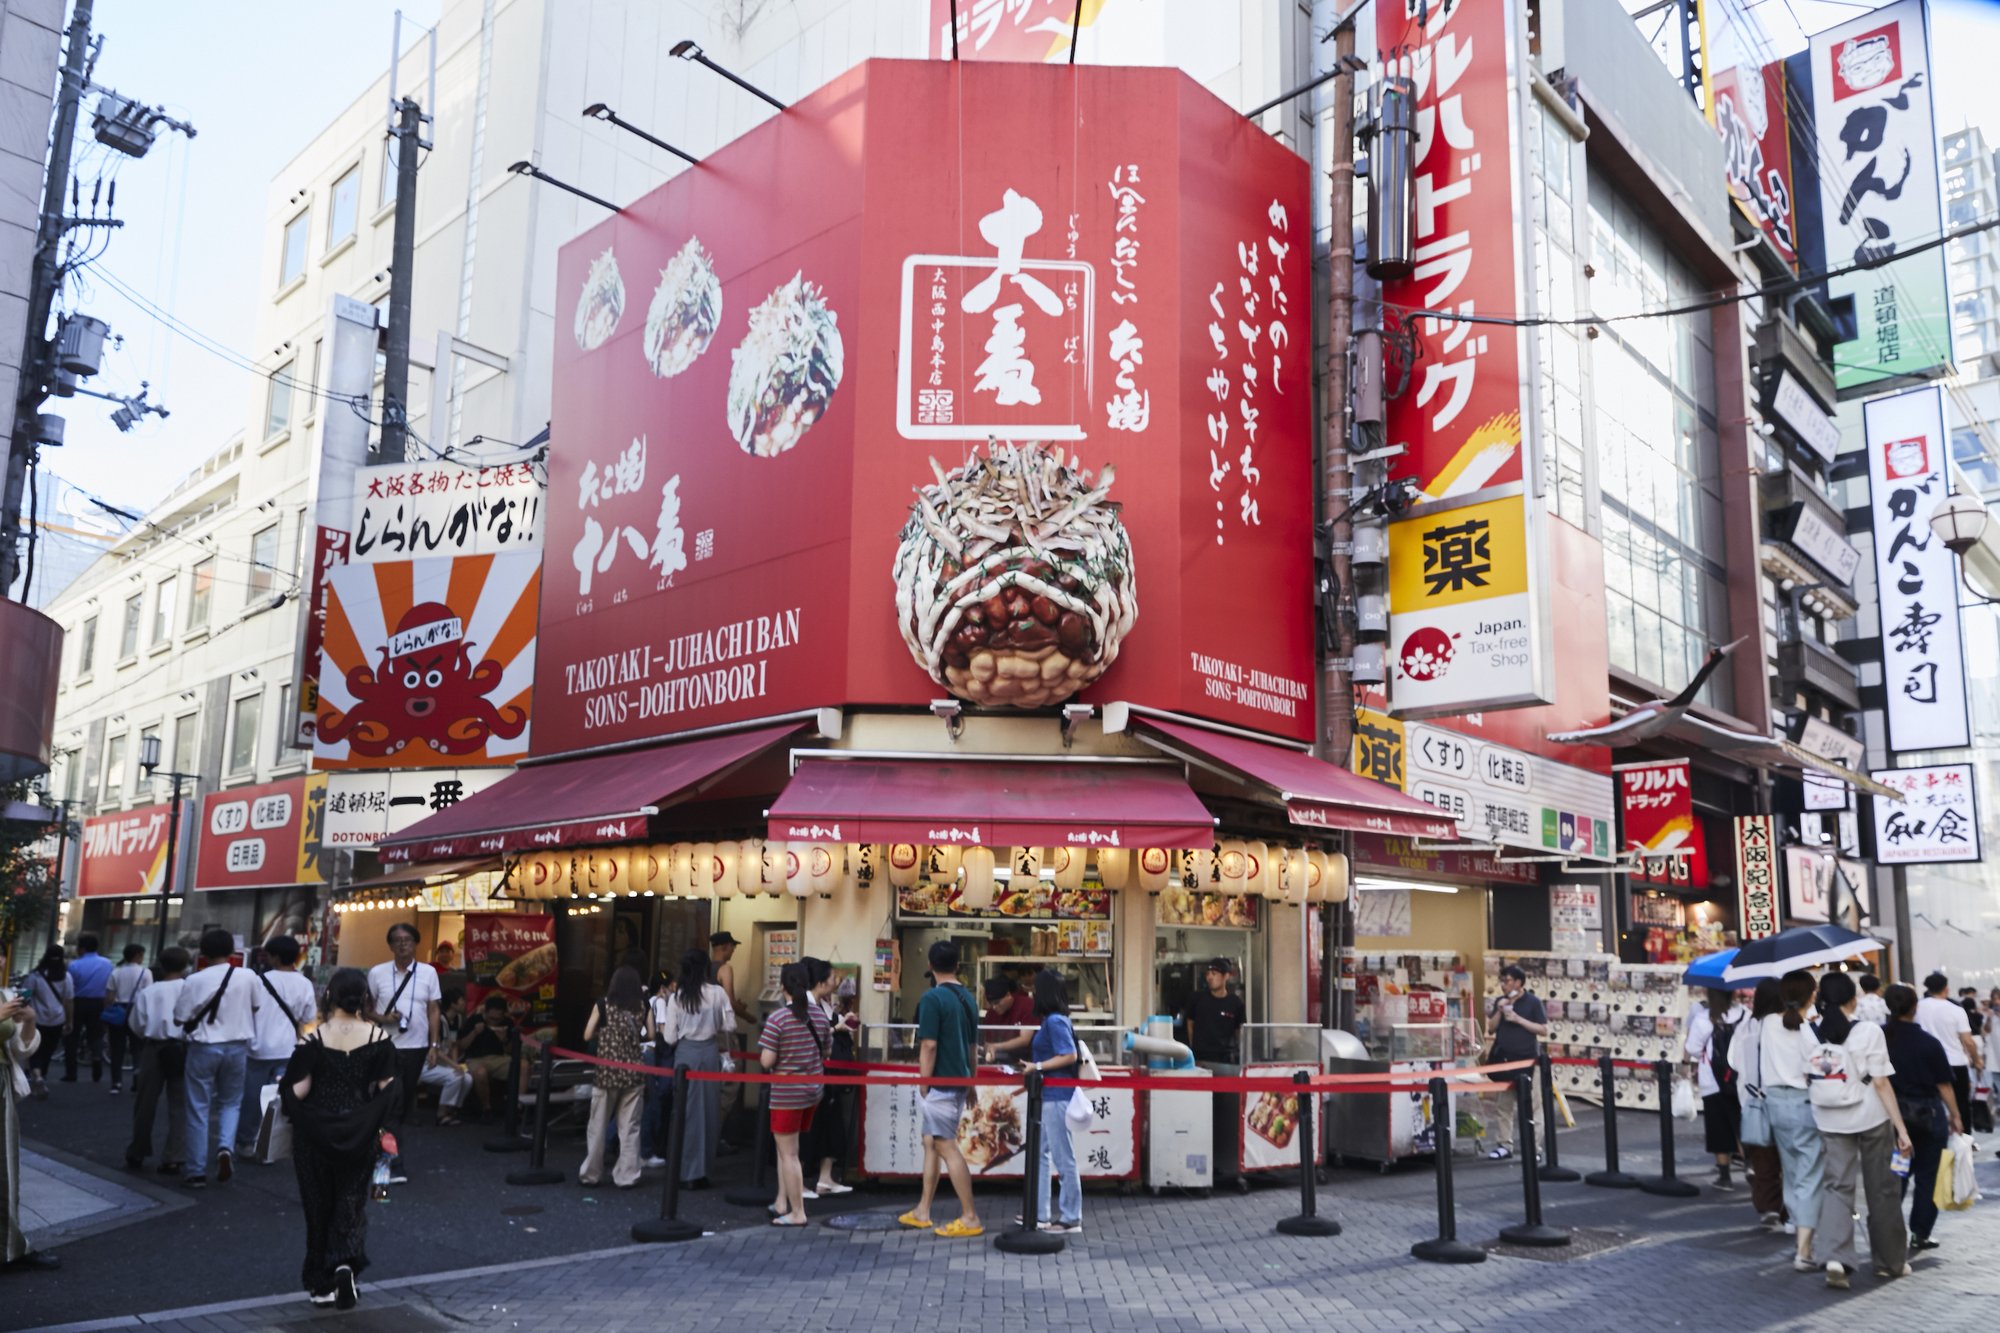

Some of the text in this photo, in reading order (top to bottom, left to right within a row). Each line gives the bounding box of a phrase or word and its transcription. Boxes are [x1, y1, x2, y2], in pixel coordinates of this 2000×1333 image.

[1065, 213, 1080, 259] じゅう
[1064, 282, 1079, 311] はち
[928, 267, 948, 386] 大阪西中島本店
[1873, 284, 1900, 365] 道頓堀店
[1063, 335, 1080, 365] ばん
[1422, 519, 1492, 597] 薬
[1474, 618, 1527, 636] Japan.
[566, 607, 801, 696] TAKOYAKI-JUHACHIBAN
[1469, 635, 1528, 655] Tax-free
[1490, 651, 1529, 668] Shop
[584, 660, 768, 730] SONS-DOHTONBORI
[1205, 677, 1296, 718] SONS-DOHTONBORI
[1422, 736, 1465, 771] くすり
[1487, 753, 1526, 786] 化粧品
[1623, 767, 1689, 793] ツルハ
[256, 799, 286, 825] 化粧品
[328, 790, 387, 815] 道頓堀
[1625, 791, 1678, 811] ドラッグ
[215, 806, 244, 830] くすり
[1883, 807, 1969, 846] 和食
[332, 832, 396, 843] DOTONBO
[231, 843, 260, 866] 日用品
[471, 928, 551, 942] Best Menu
